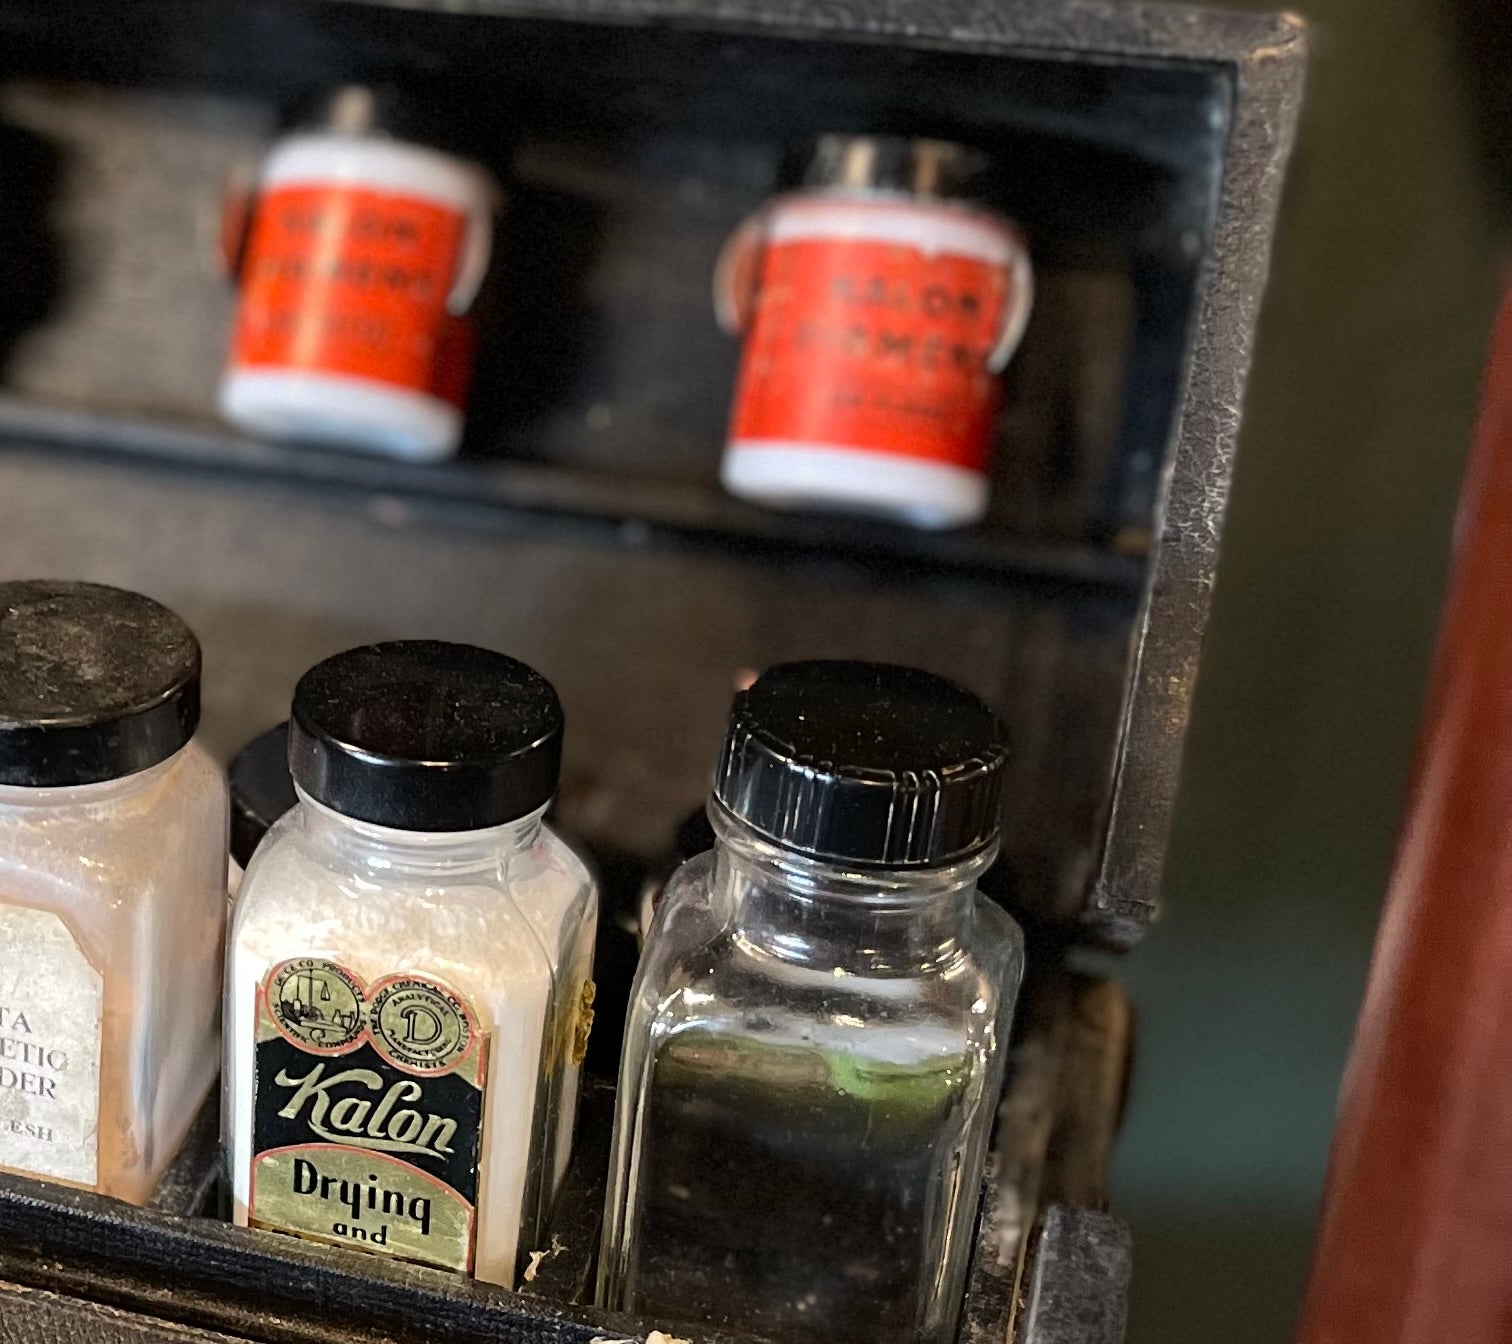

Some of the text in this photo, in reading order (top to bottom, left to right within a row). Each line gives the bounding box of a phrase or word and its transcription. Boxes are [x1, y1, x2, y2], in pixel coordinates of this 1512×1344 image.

[400, 1004, 443, 1045] D
[274, 1062, 458, 1162] Kalon
[292, 1158, 431, 1236] Drying
[333, 1222, 387, 1246] and
